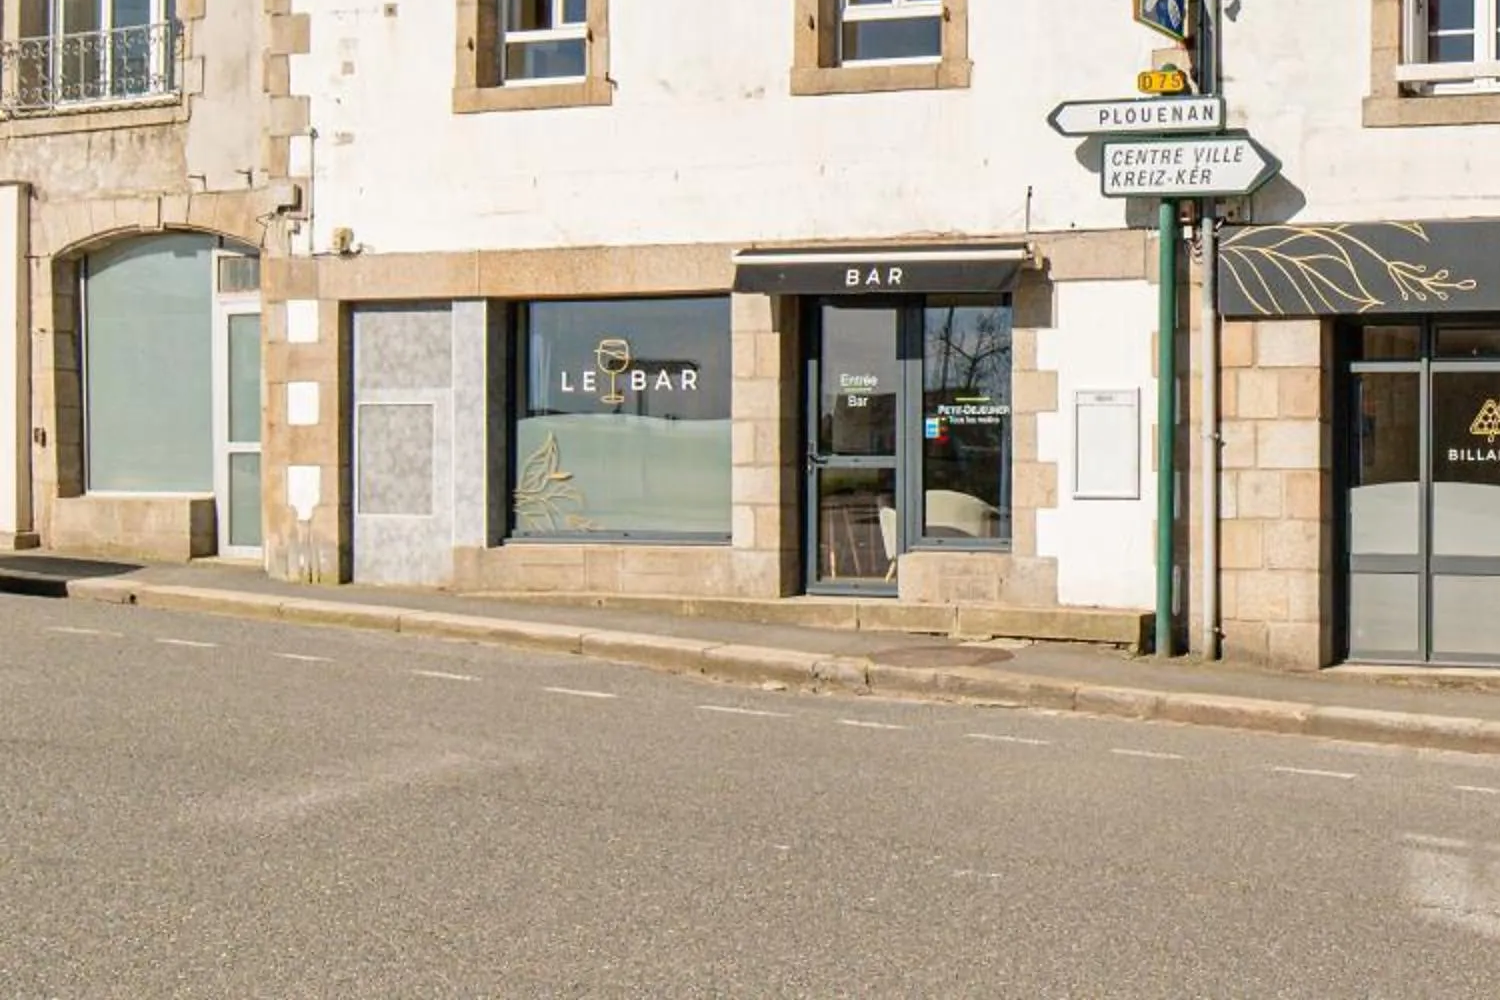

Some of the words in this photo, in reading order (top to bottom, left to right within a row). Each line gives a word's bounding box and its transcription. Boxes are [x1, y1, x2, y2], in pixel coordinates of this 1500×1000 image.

[1099, 105, 1214, 125] PLOUENAN
[1112, 147, 1184, 167] CENTRE
[1194, 145, 1244, 164] VILLE
[845, 267, 903, 287] BAR
[561, 371, 597, 392] LE
[631, 369, 698, 391] BAR
[848, 395, 868, 407] Bar
